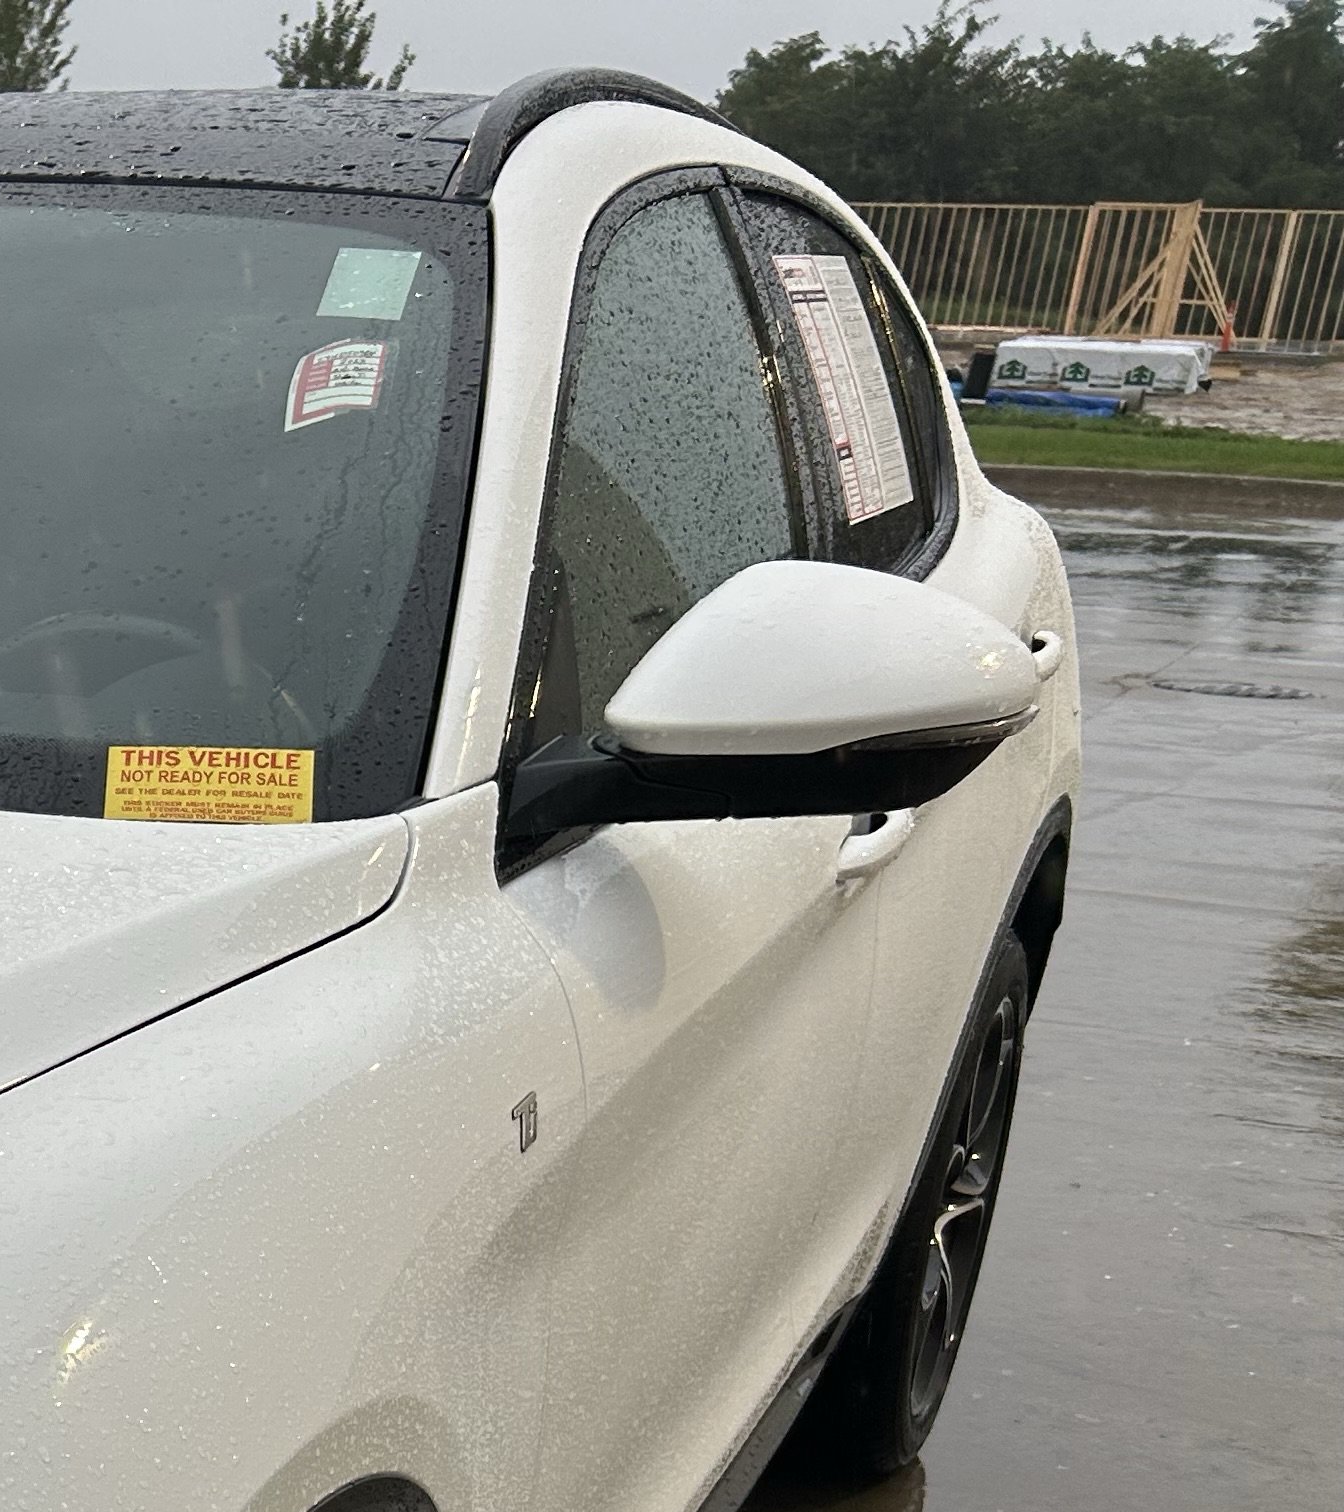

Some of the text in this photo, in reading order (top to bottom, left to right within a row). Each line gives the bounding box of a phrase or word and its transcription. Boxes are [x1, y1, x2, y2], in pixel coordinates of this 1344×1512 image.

[121, 749, 302, 771] THIS VEHICLE
[120, 769, 299, 787] NOT READY FOR SALE
[115, 787, 304, 800] SEE THE DEALER FOR RESALE DATE
